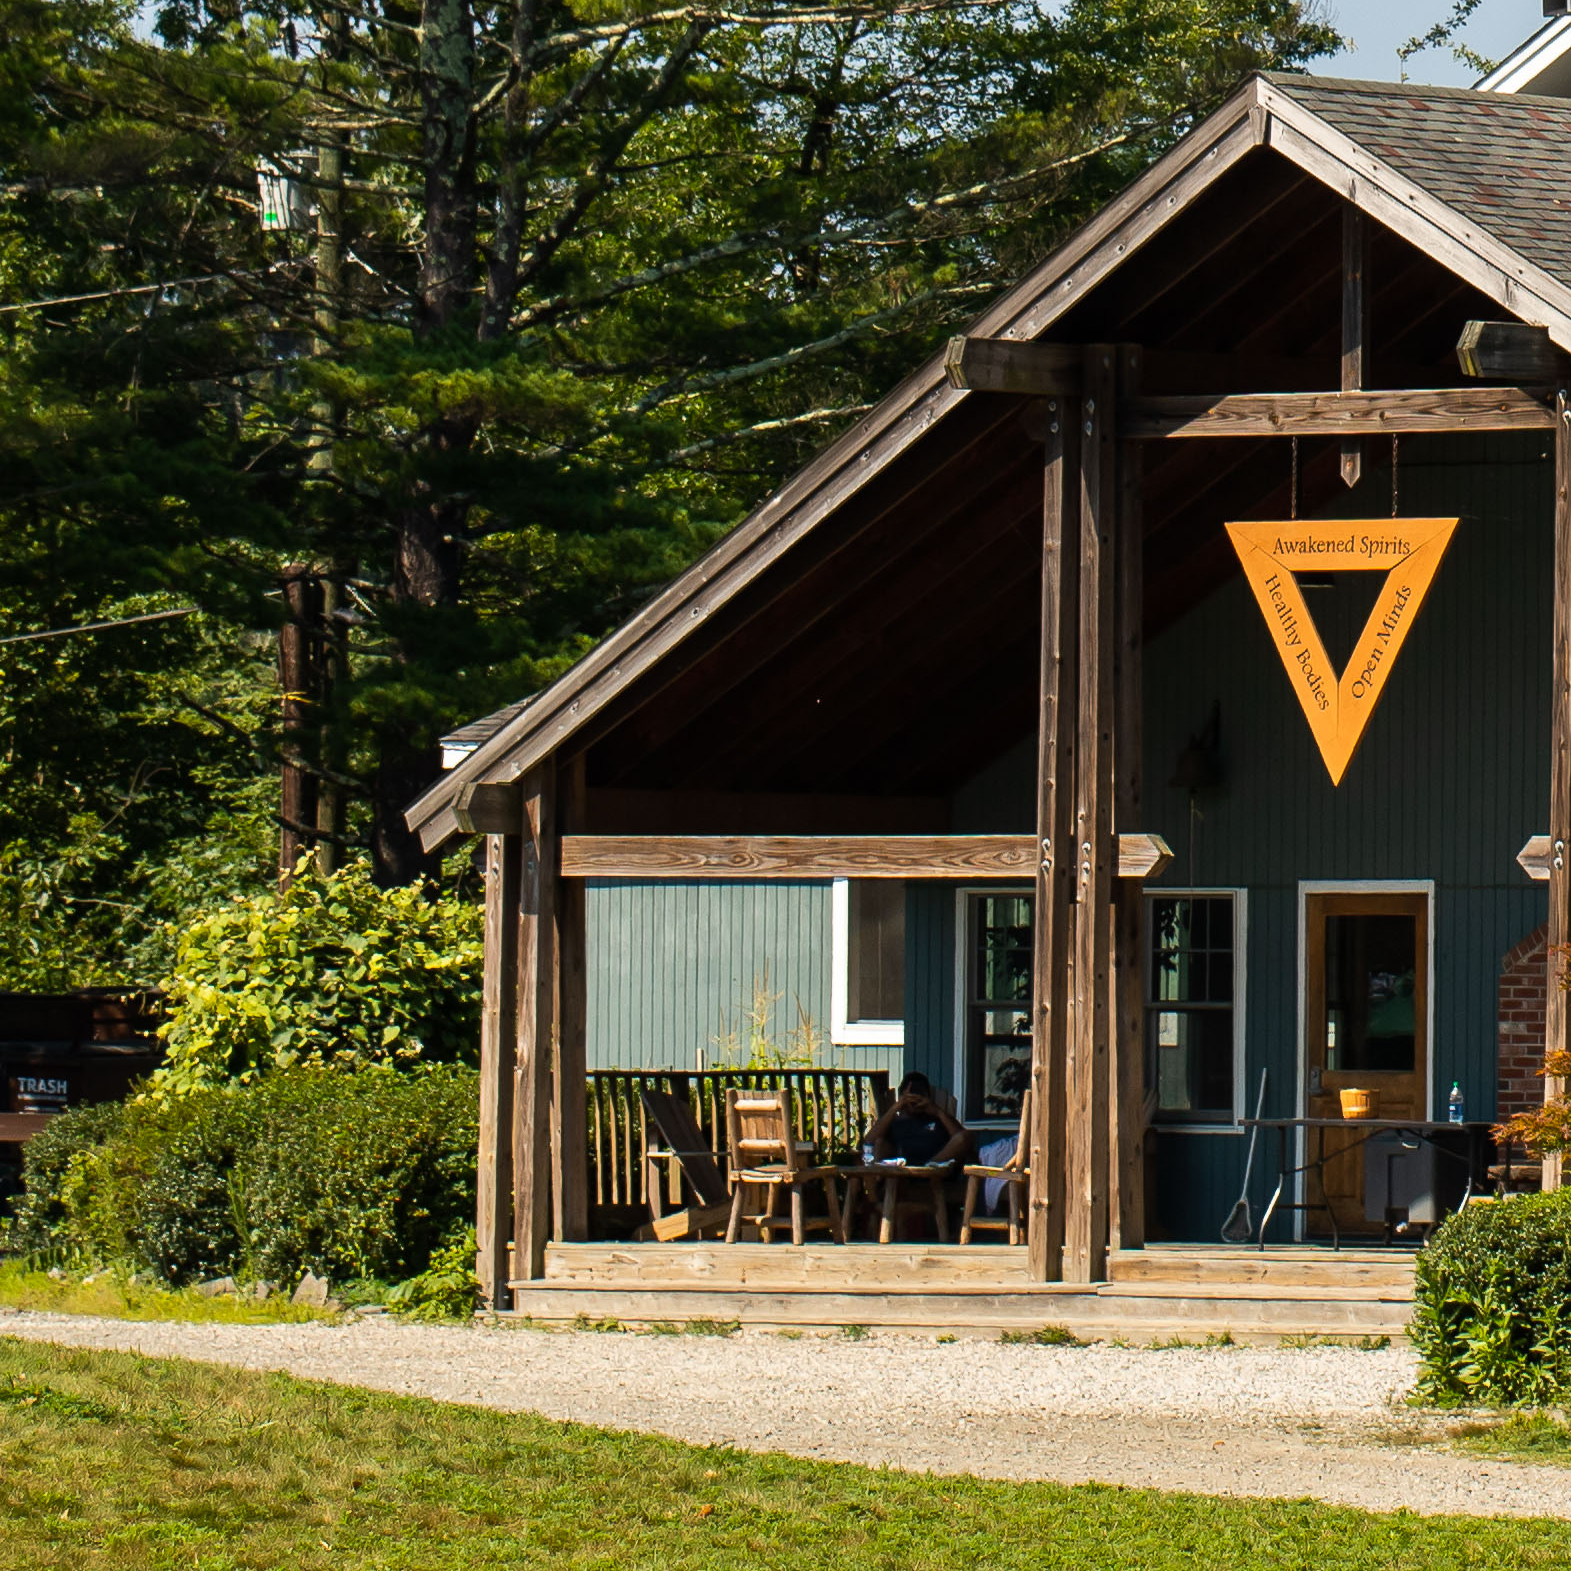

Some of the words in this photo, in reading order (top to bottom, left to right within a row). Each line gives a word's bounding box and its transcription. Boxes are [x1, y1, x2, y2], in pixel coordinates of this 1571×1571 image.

[1273, 535, 1355, 555] Awakened
[1359, 536, 1411, 558] Spirits
[1265, 574, 1301, 646] Healthy
[1296, 648, 1329, 710] Bodies
[1352, 648, 1383, 698] Open
[1377, 585, 1411, 645] Minds
[17, 1077, 67, 1094] TRASH
